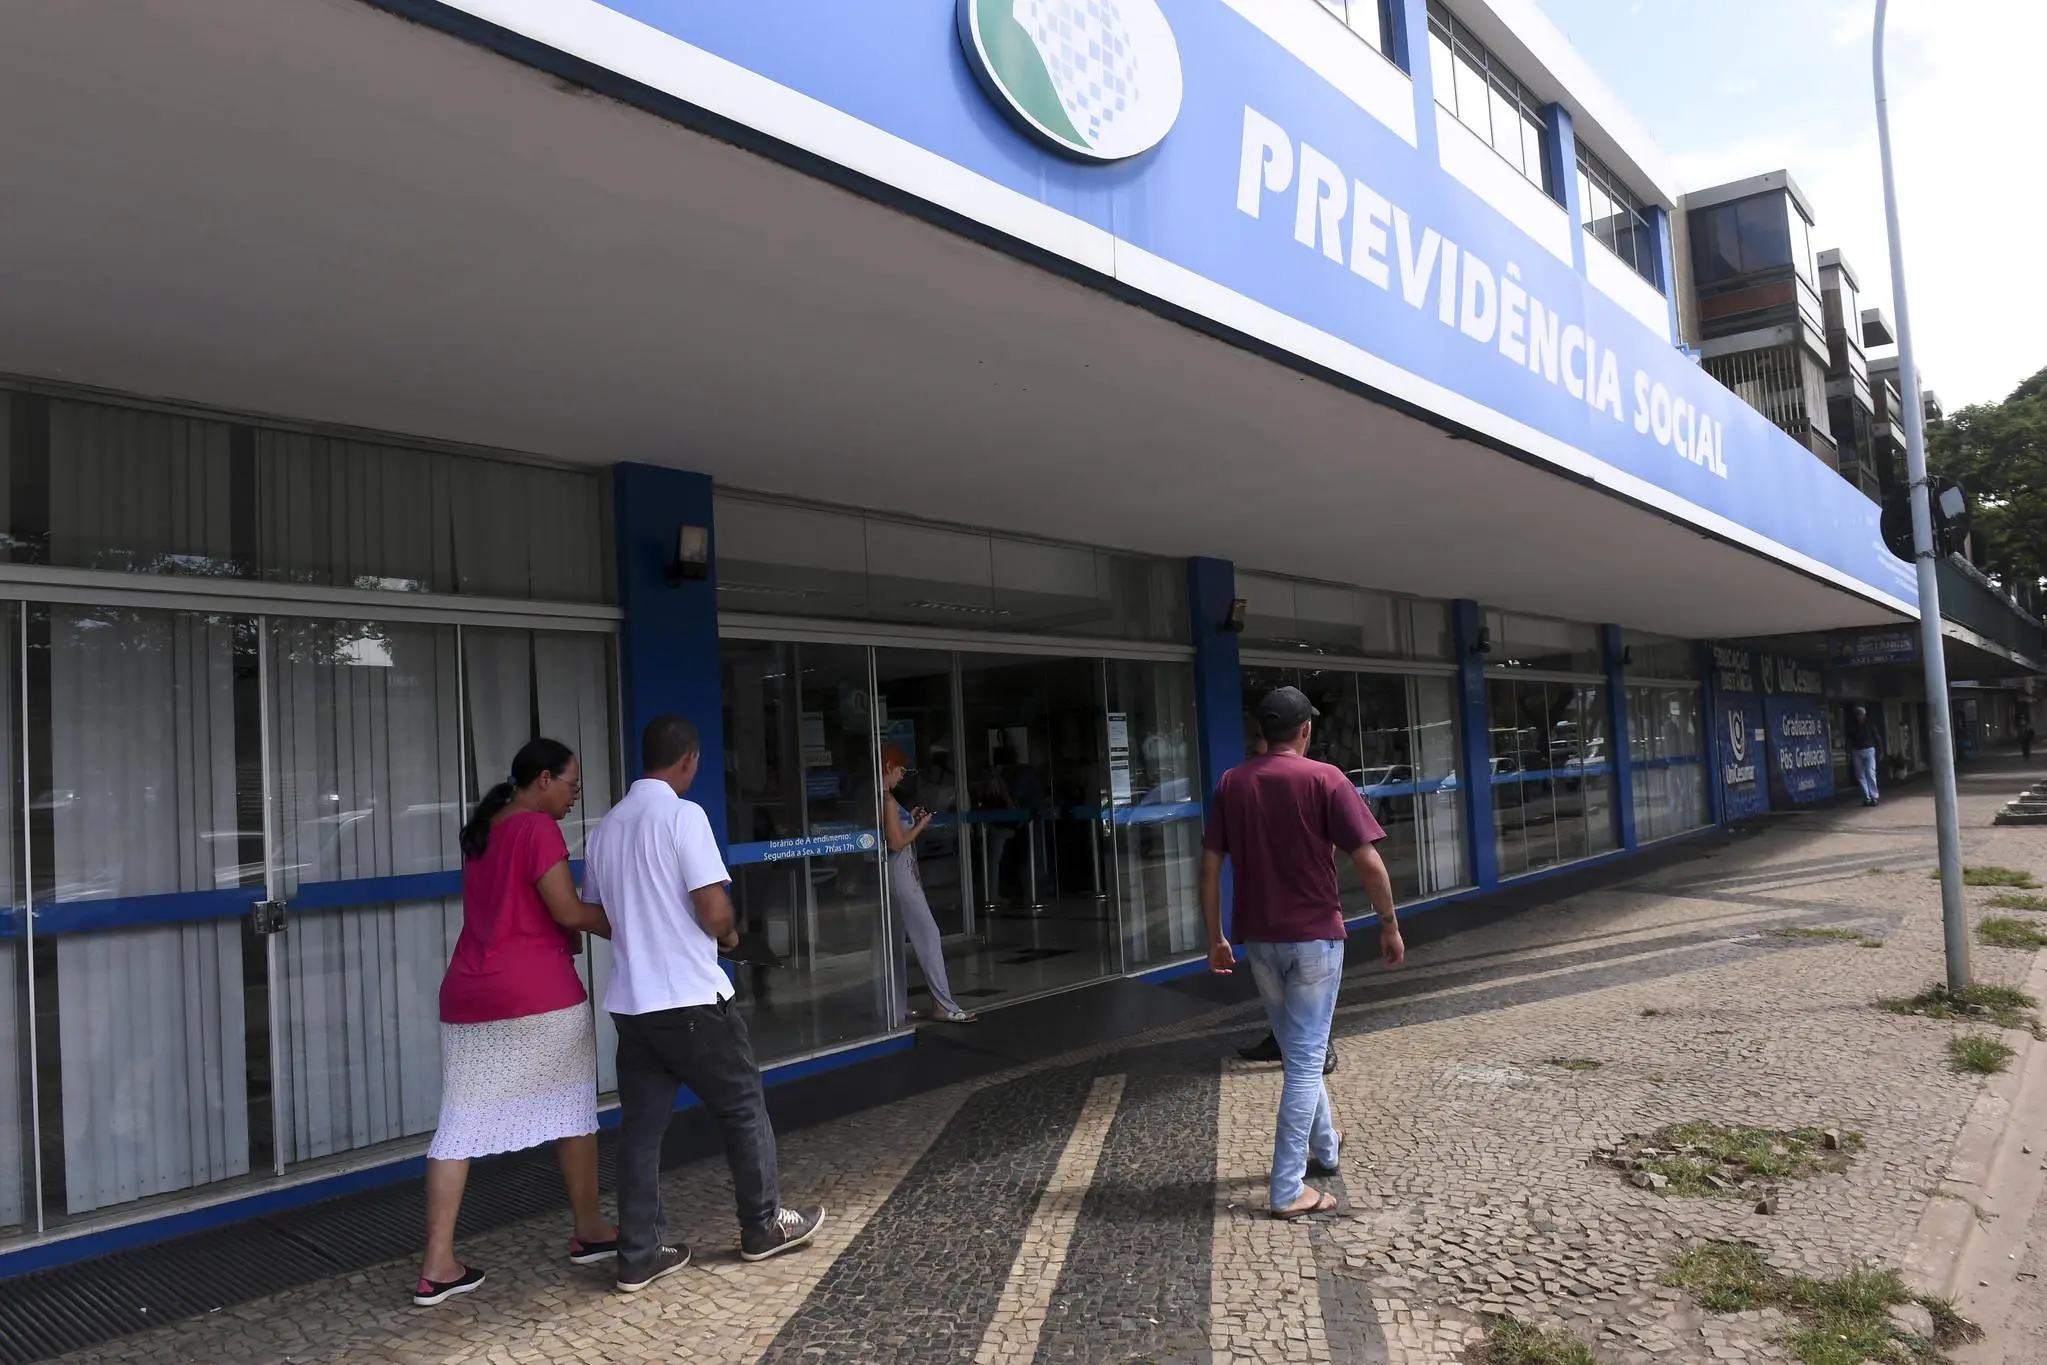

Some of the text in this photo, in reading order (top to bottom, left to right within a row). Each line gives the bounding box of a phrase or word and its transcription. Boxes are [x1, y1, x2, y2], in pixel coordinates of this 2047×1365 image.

[1236, 103, 1728, 480] PREVIDÊNCIA SOCIAL
[1782, 713, 1816, 741] Graduação
[1795, 744, 1826, 769] Graduação
[795, 837, 804, 846] de
[805, 833, 852, 845] Aendimento:
[763, 851, 795, 861] Segunda
